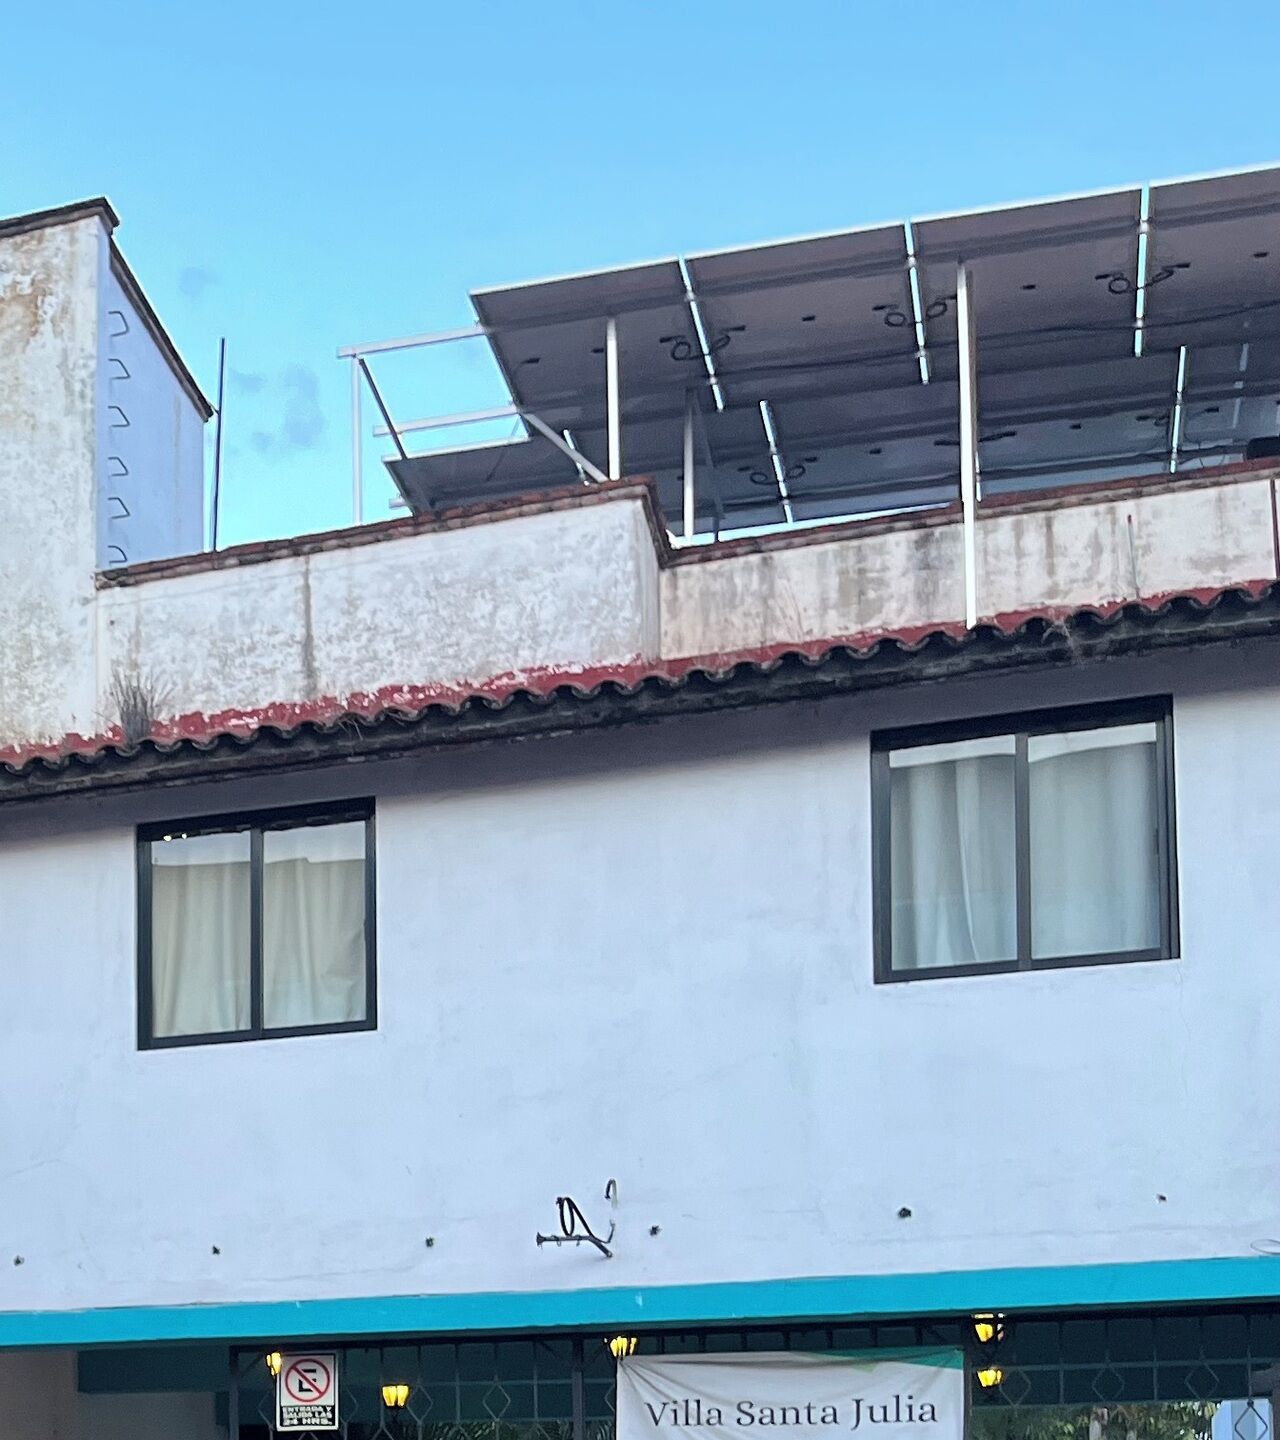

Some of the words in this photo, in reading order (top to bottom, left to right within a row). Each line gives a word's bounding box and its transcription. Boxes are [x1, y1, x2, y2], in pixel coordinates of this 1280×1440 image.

[644, 1399, 724, 1427] Villa
[735, 1400, 840, 1427] Santa
[850, 1395, 938, 1431] Julia
